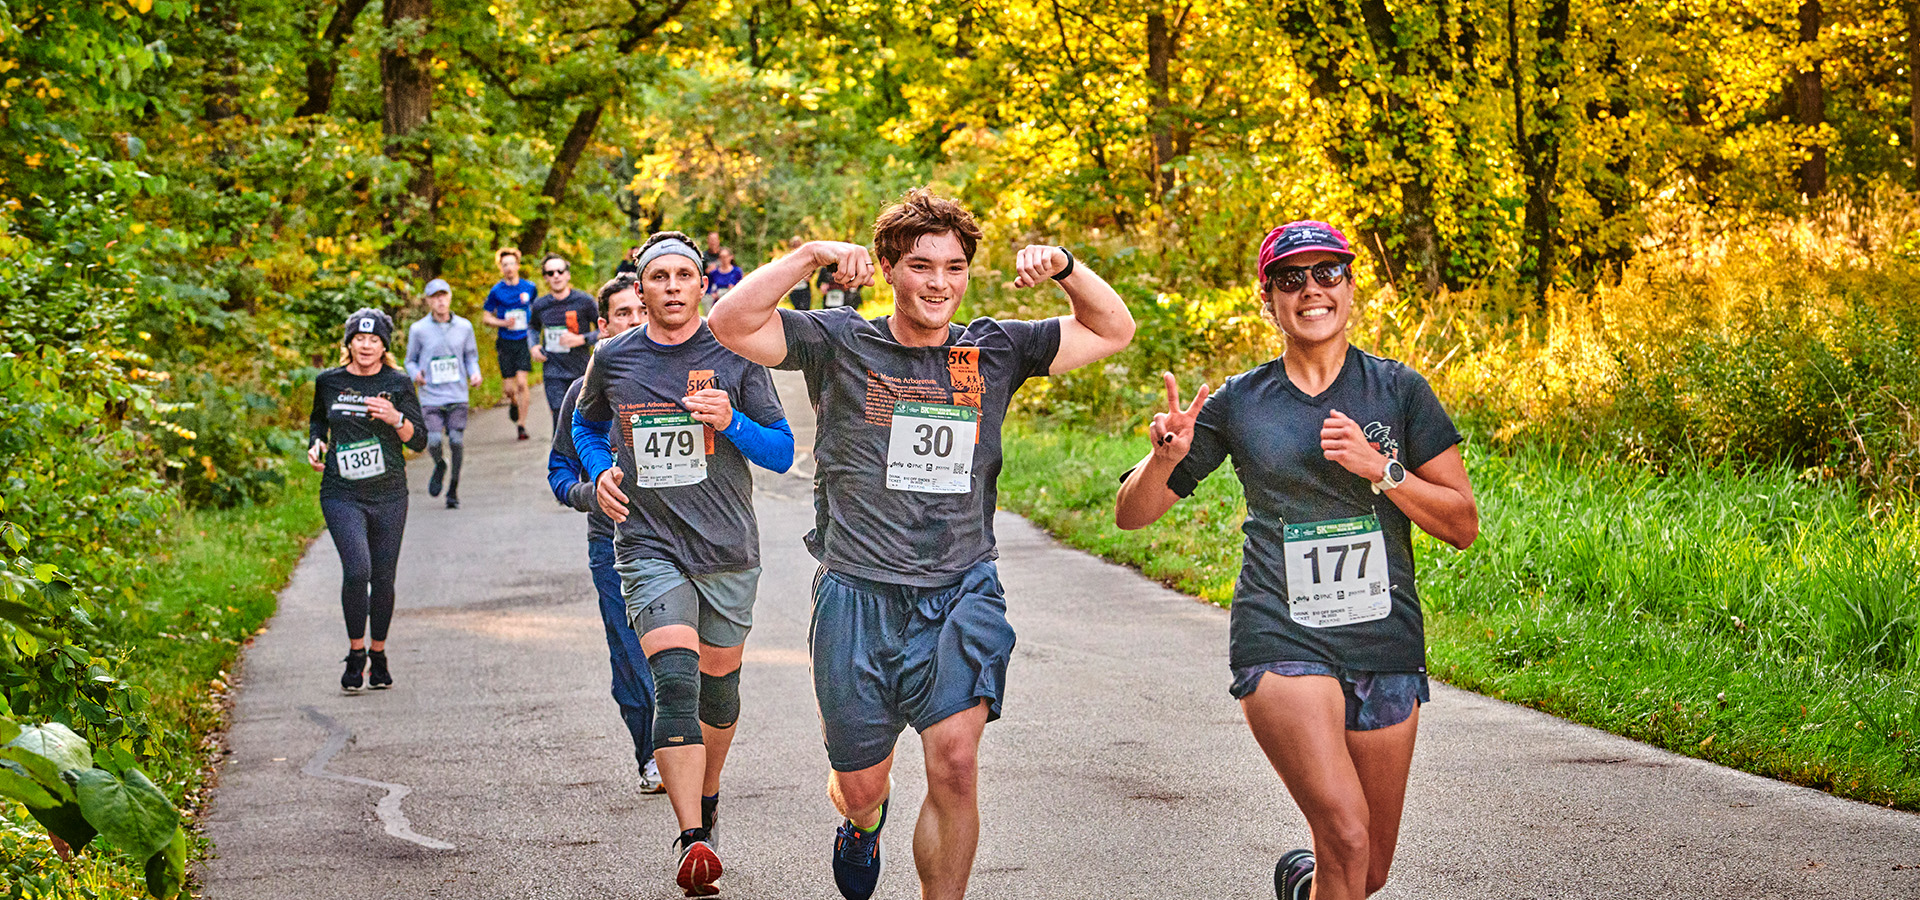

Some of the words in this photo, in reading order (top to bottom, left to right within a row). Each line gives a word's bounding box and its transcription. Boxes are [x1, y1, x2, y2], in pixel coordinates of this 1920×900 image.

[949, 351, 971, 365] 5K
[880, 373, 902, 383] Morton
[903, 377, 937, 385] Arboretum
[645, 430, 694, 458] 479
[913, 424, 954, 458] 30
[341, 448, 380, 471] 1387
[1304, 541, 1371, 584] 177
